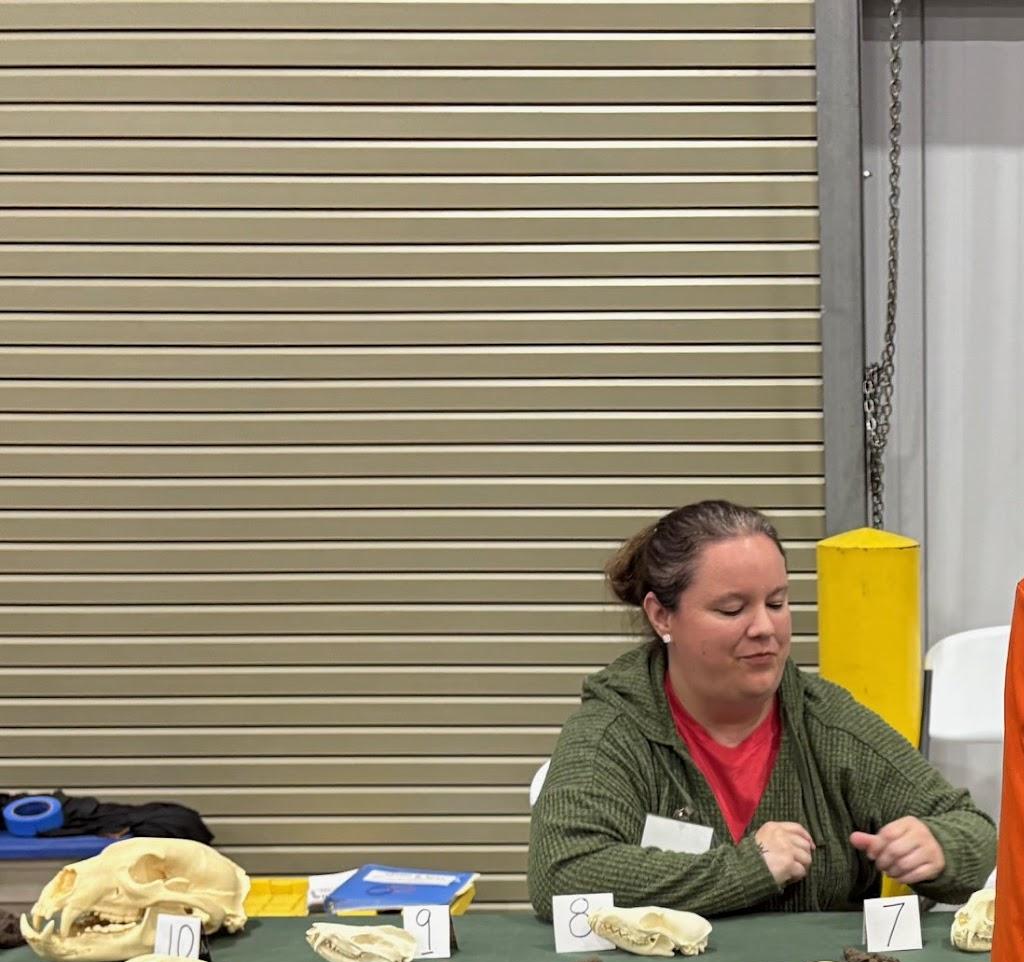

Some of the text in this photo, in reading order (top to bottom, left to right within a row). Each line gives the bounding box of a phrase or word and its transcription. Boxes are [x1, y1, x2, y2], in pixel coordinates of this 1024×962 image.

[416, 908, 434, 956] 9
[568, 897, 592, 938] 8
[882, 902, 905, 947] 7
[168, 923, 195, 958] 10
